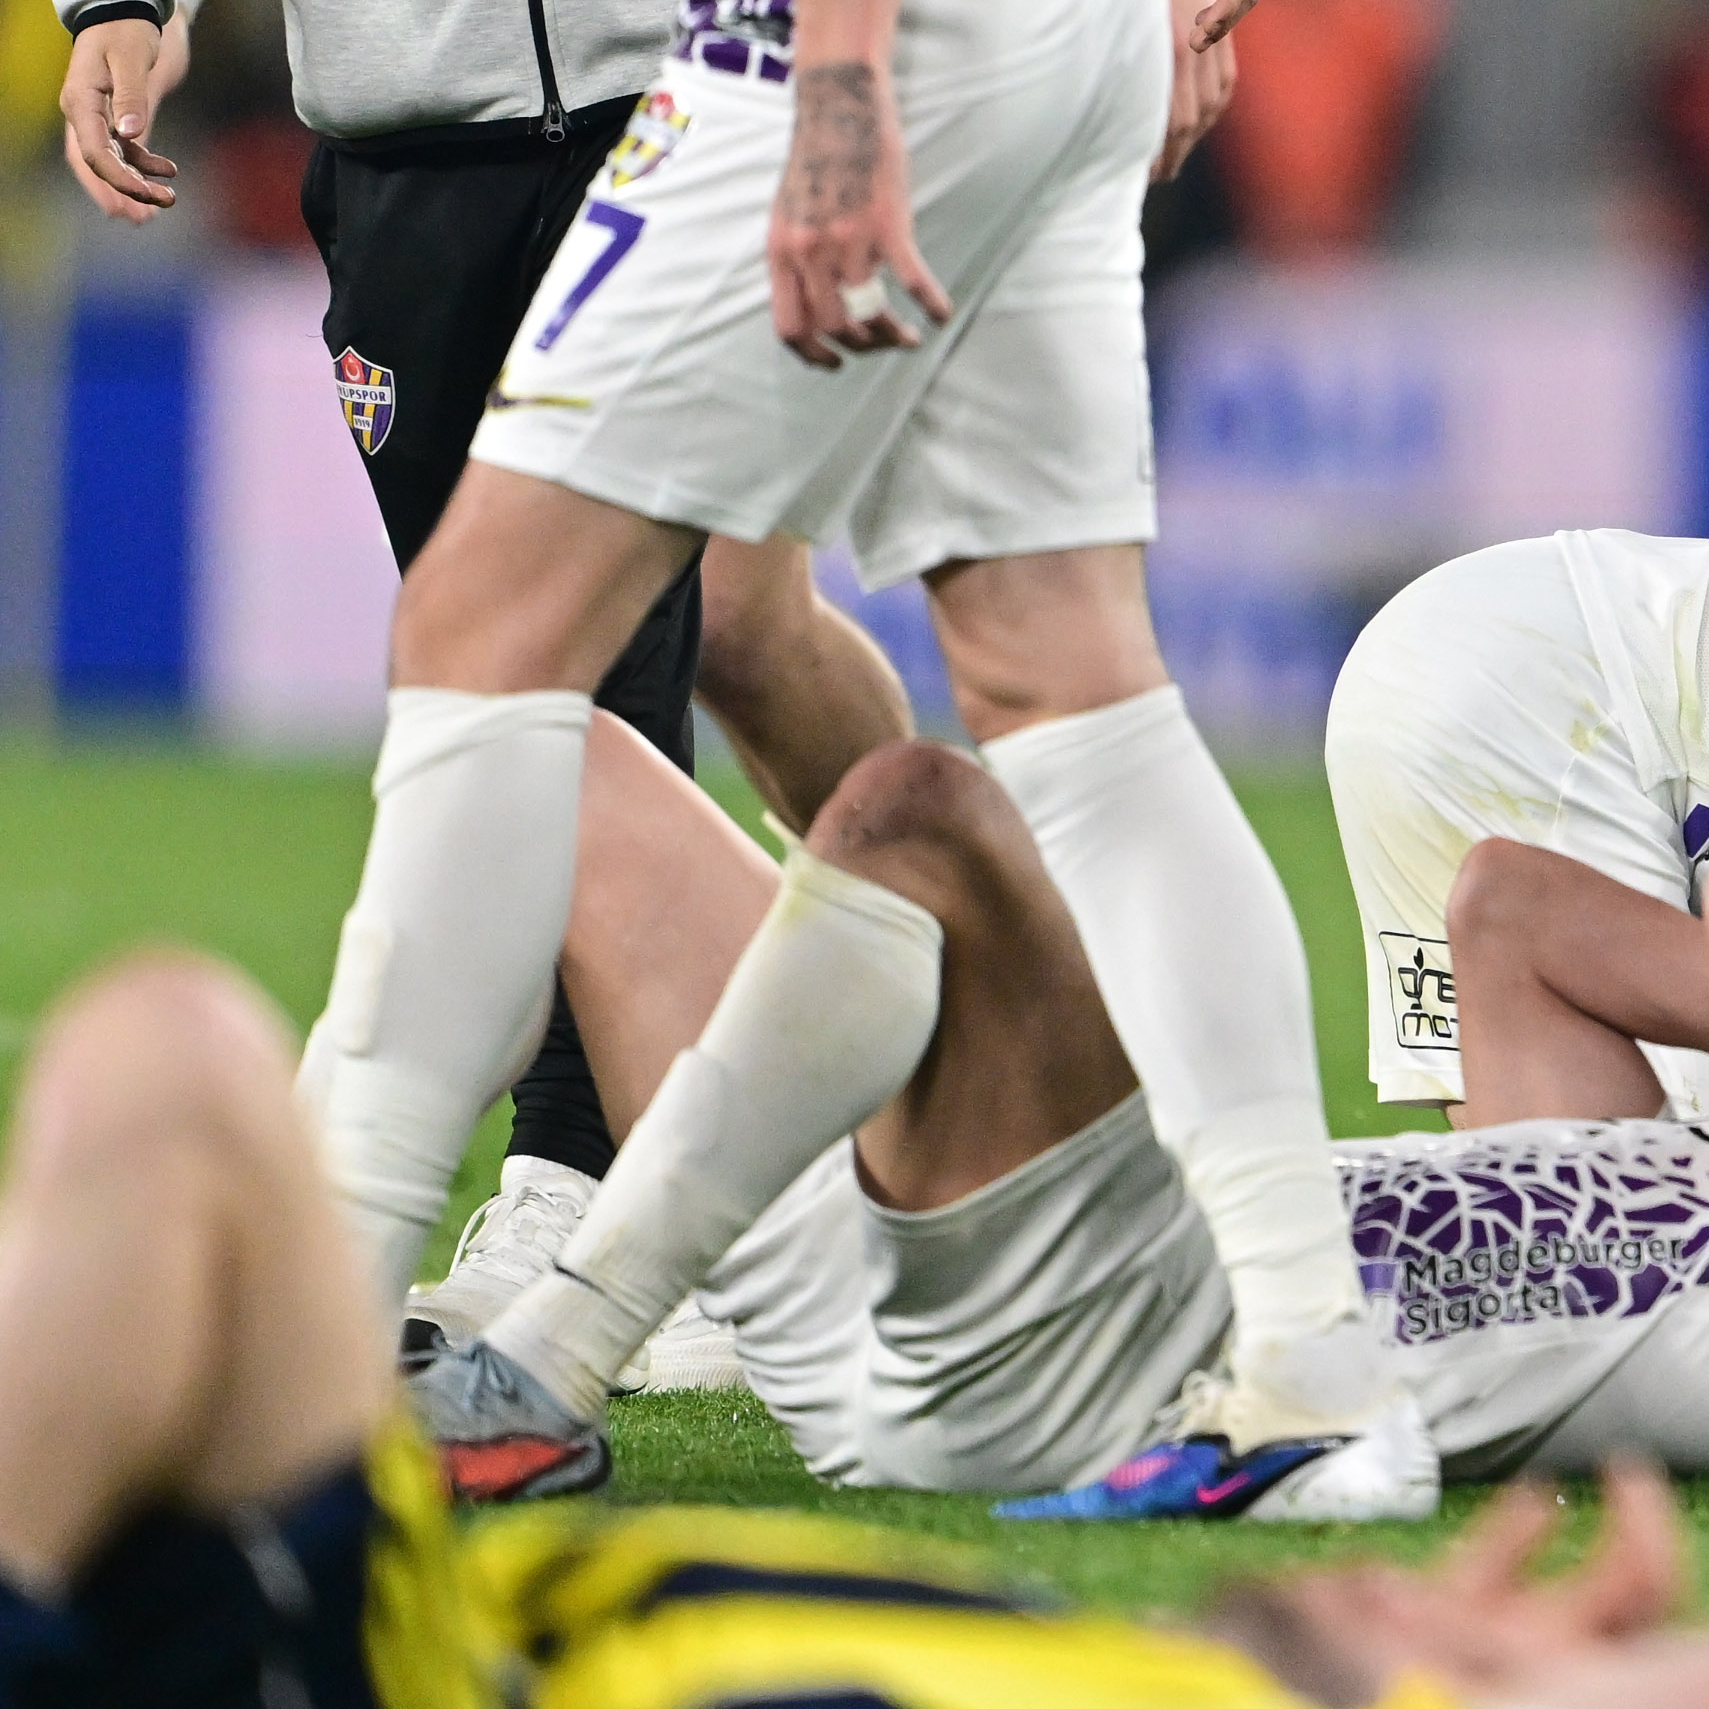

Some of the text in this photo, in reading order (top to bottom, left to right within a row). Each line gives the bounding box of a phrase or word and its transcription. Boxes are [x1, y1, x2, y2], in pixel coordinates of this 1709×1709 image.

[533, 199, 645, 352] 7
[1404, 1235, 1686, 1293] Magdeburger
[1405, 1283, 1561, 1335] Sigorta
